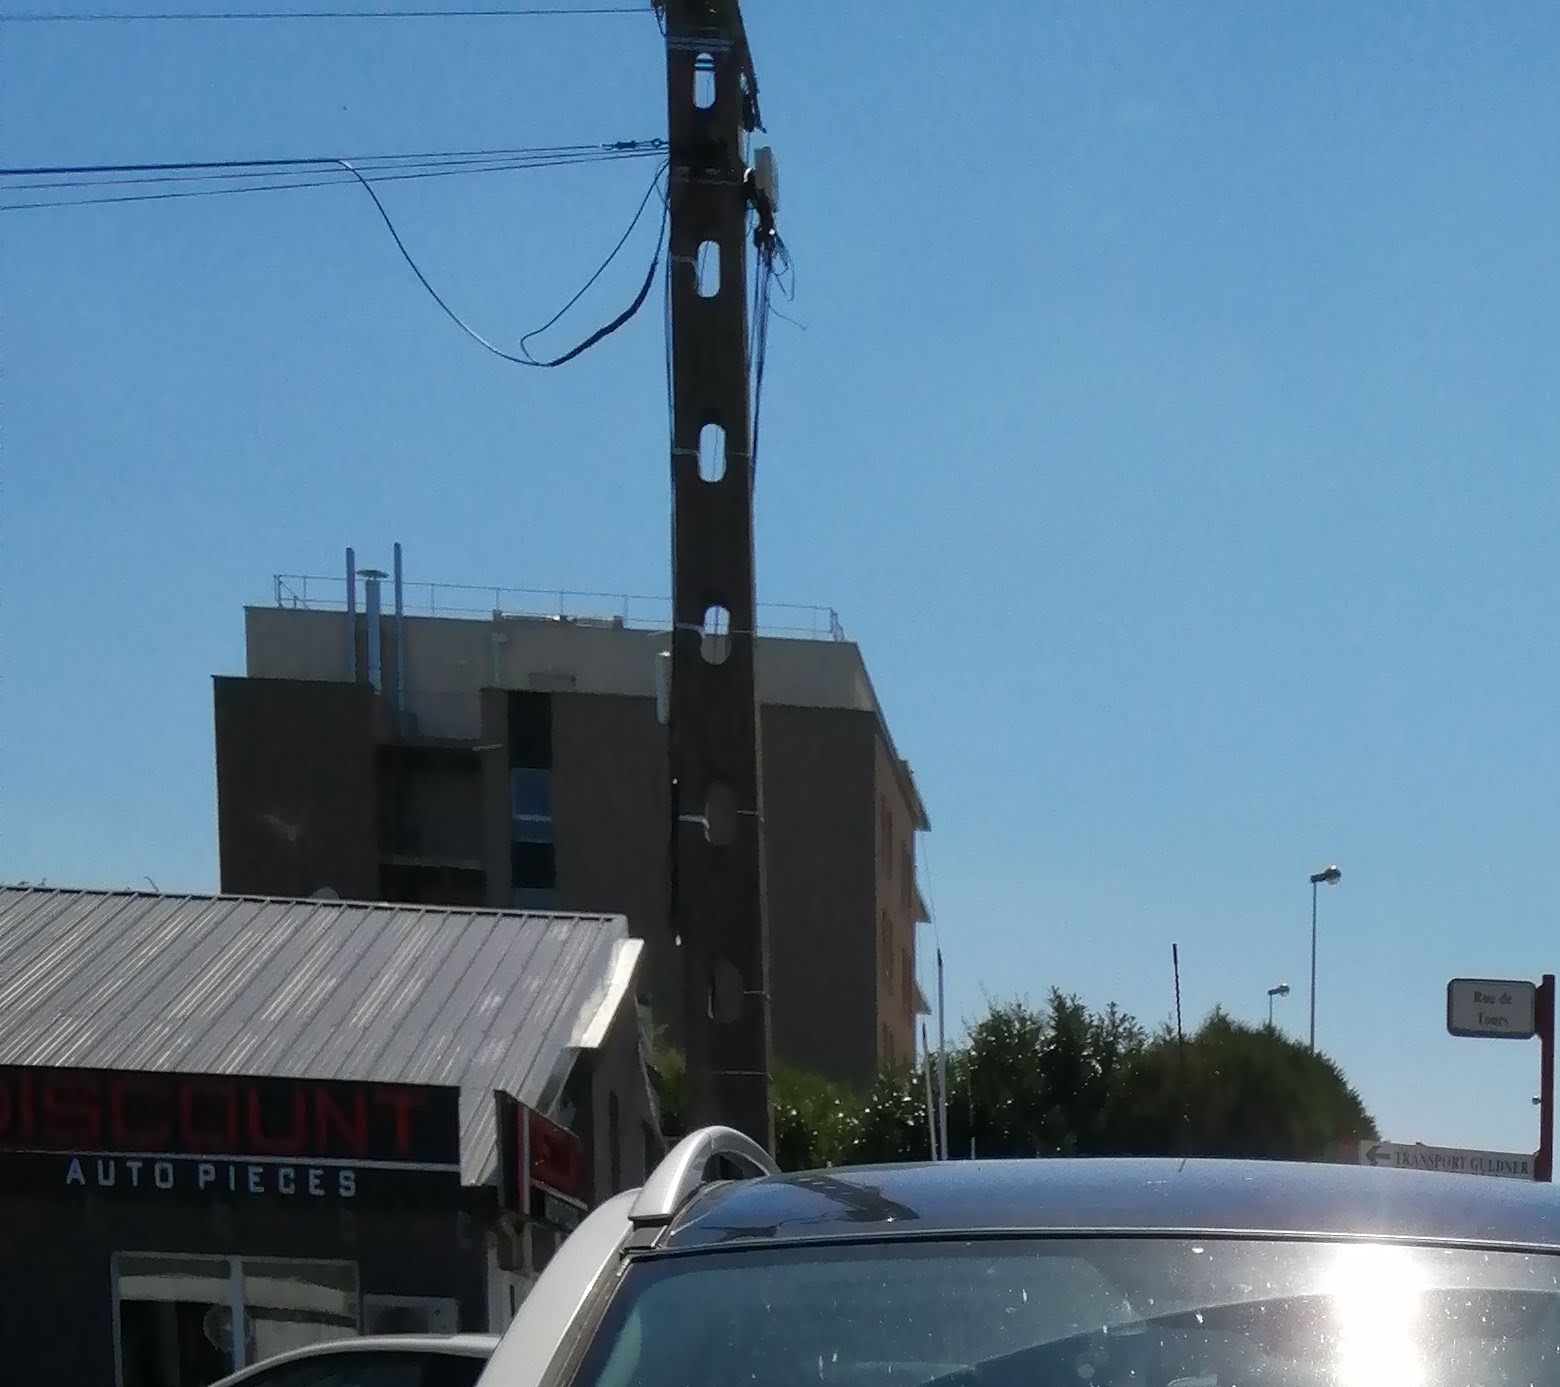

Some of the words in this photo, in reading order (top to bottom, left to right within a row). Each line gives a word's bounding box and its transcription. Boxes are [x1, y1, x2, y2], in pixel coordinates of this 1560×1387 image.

[0, 1072, 428, 1156] ISCOUNT
[66, 1157, 176, 1190] AUTO
[197, 1162, 358, 1198] PIECES
